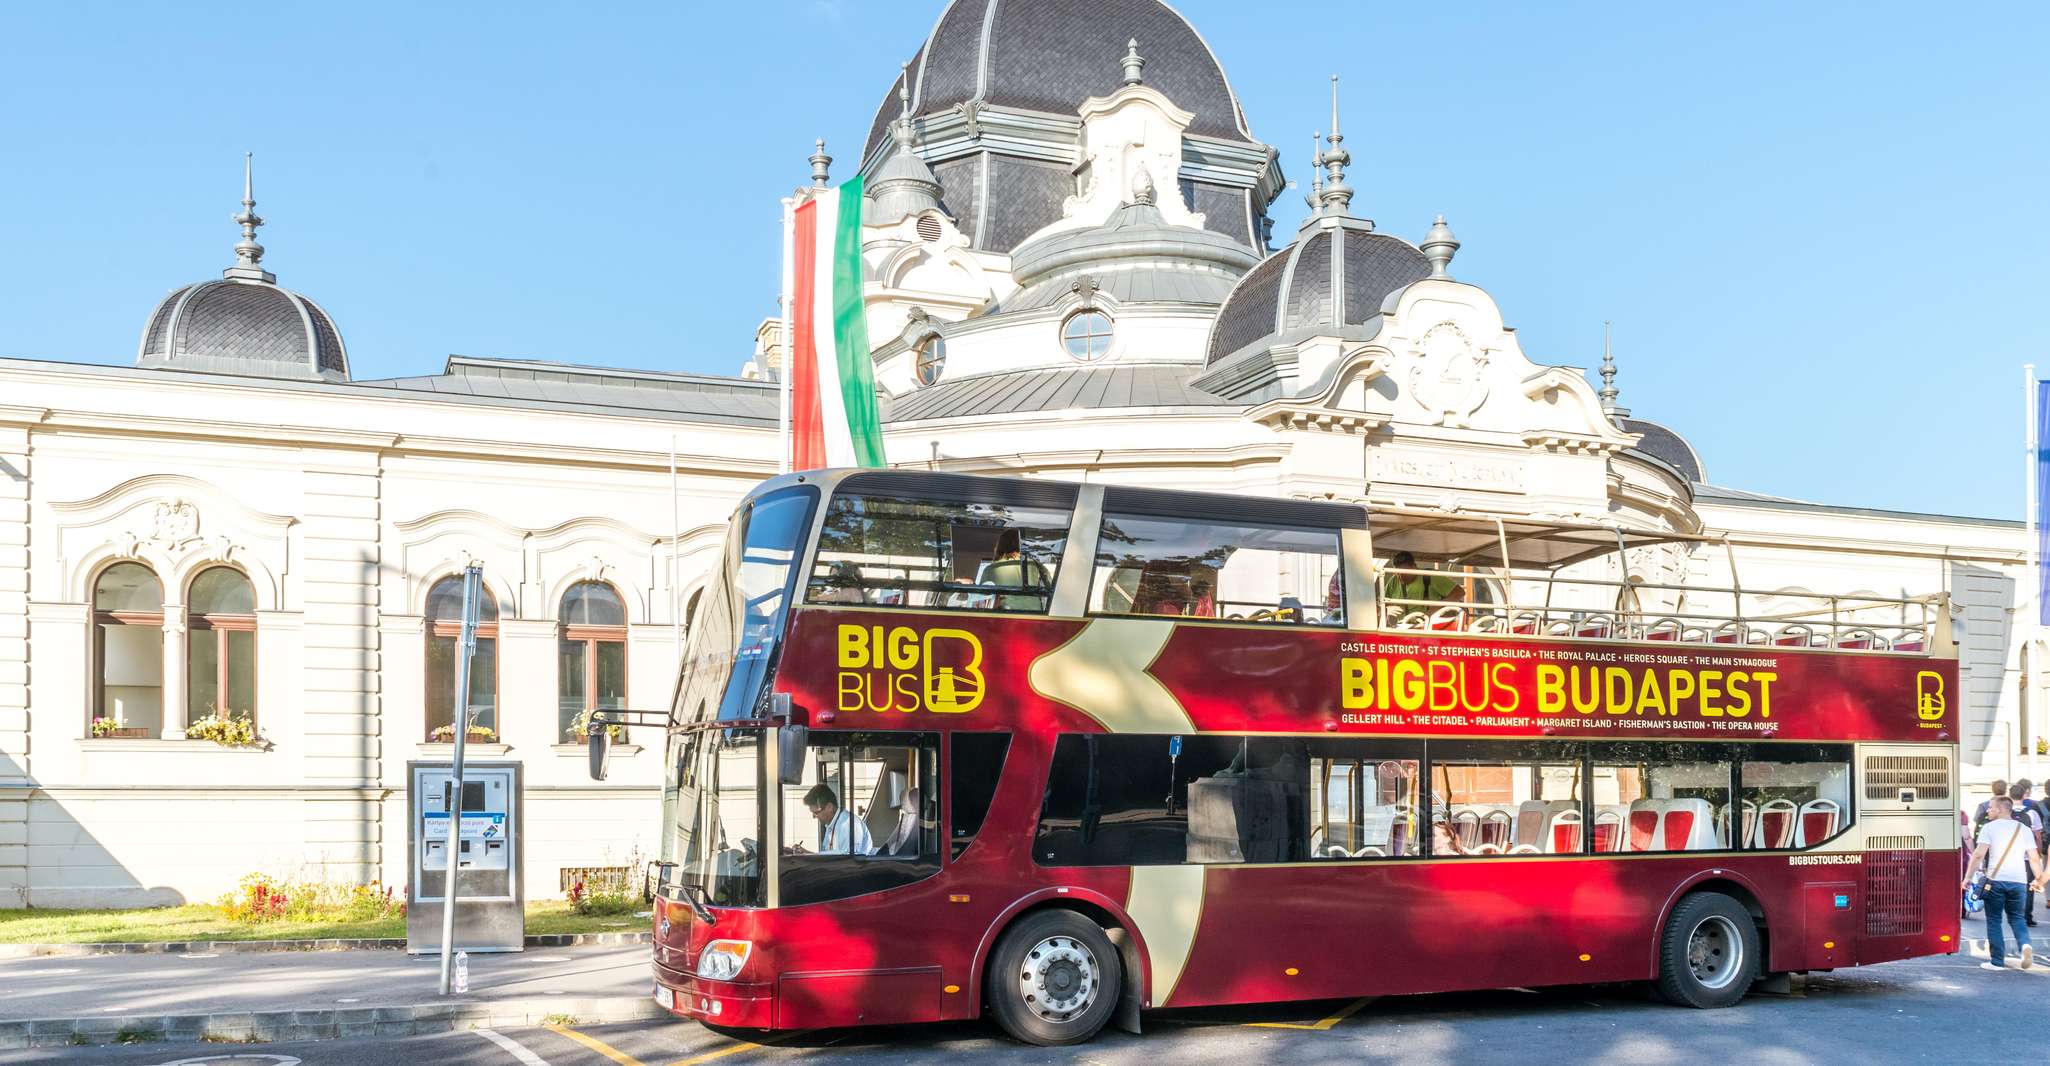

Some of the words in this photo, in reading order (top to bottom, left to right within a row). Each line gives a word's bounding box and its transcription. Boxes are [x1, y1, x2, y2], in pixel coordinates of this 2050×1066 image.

[838, 624, 919, 670] BIG
[1341, 643, 1376, 653] CASTLE
[1379, 644, 1419, 655] DISTRICT
[1427, 646, 1438, 655] ST
[1441, 646, 1490, 657] STEPHEN'S
[1492, 648, 1531, 658] BASILICA
[1539, 650, 1555, 660] THE
[1558, 651, 1583, 661] ROYAL
[1585, 652, 1616, 662] PALACE
[1623, 654, 1655, 663] HEROES
[1657, 655, 1688, 664] SQUARE
[1695, 656, 1711, 665] THE
[1712, 657, 1732, 666] MAIN
[1733, 658, 1777, 667] SYNAGOGUE
[838, 672, 920, 713] BUS
[1536, 664, 1778, 718] BUDAPEST
[1342, 714, 1382, 724] GELLERT
[1384, 715, 1405, 724] HILL
[1413, 715, 1430, 725] THE
[1432, 716, 1468, 725] CITADEL
[1476, 716, 1529, 727] PARLIAMENT
[1537, 718, 1581, 728] MARGARET
[1582, 719, 1611, 728] ISLAND
[1619, 720, 1671, 729] FISHERMAN'S
[1673, 720, 1705, 729] BASTION
[1712, 721, 1726, 730] THE
[1729, 721, 1752, 730] OPERA
[1754, 722, 1778, 731] HOUSE
[1788, 855, 1862, 866] BIGBUSTOURS.COM
